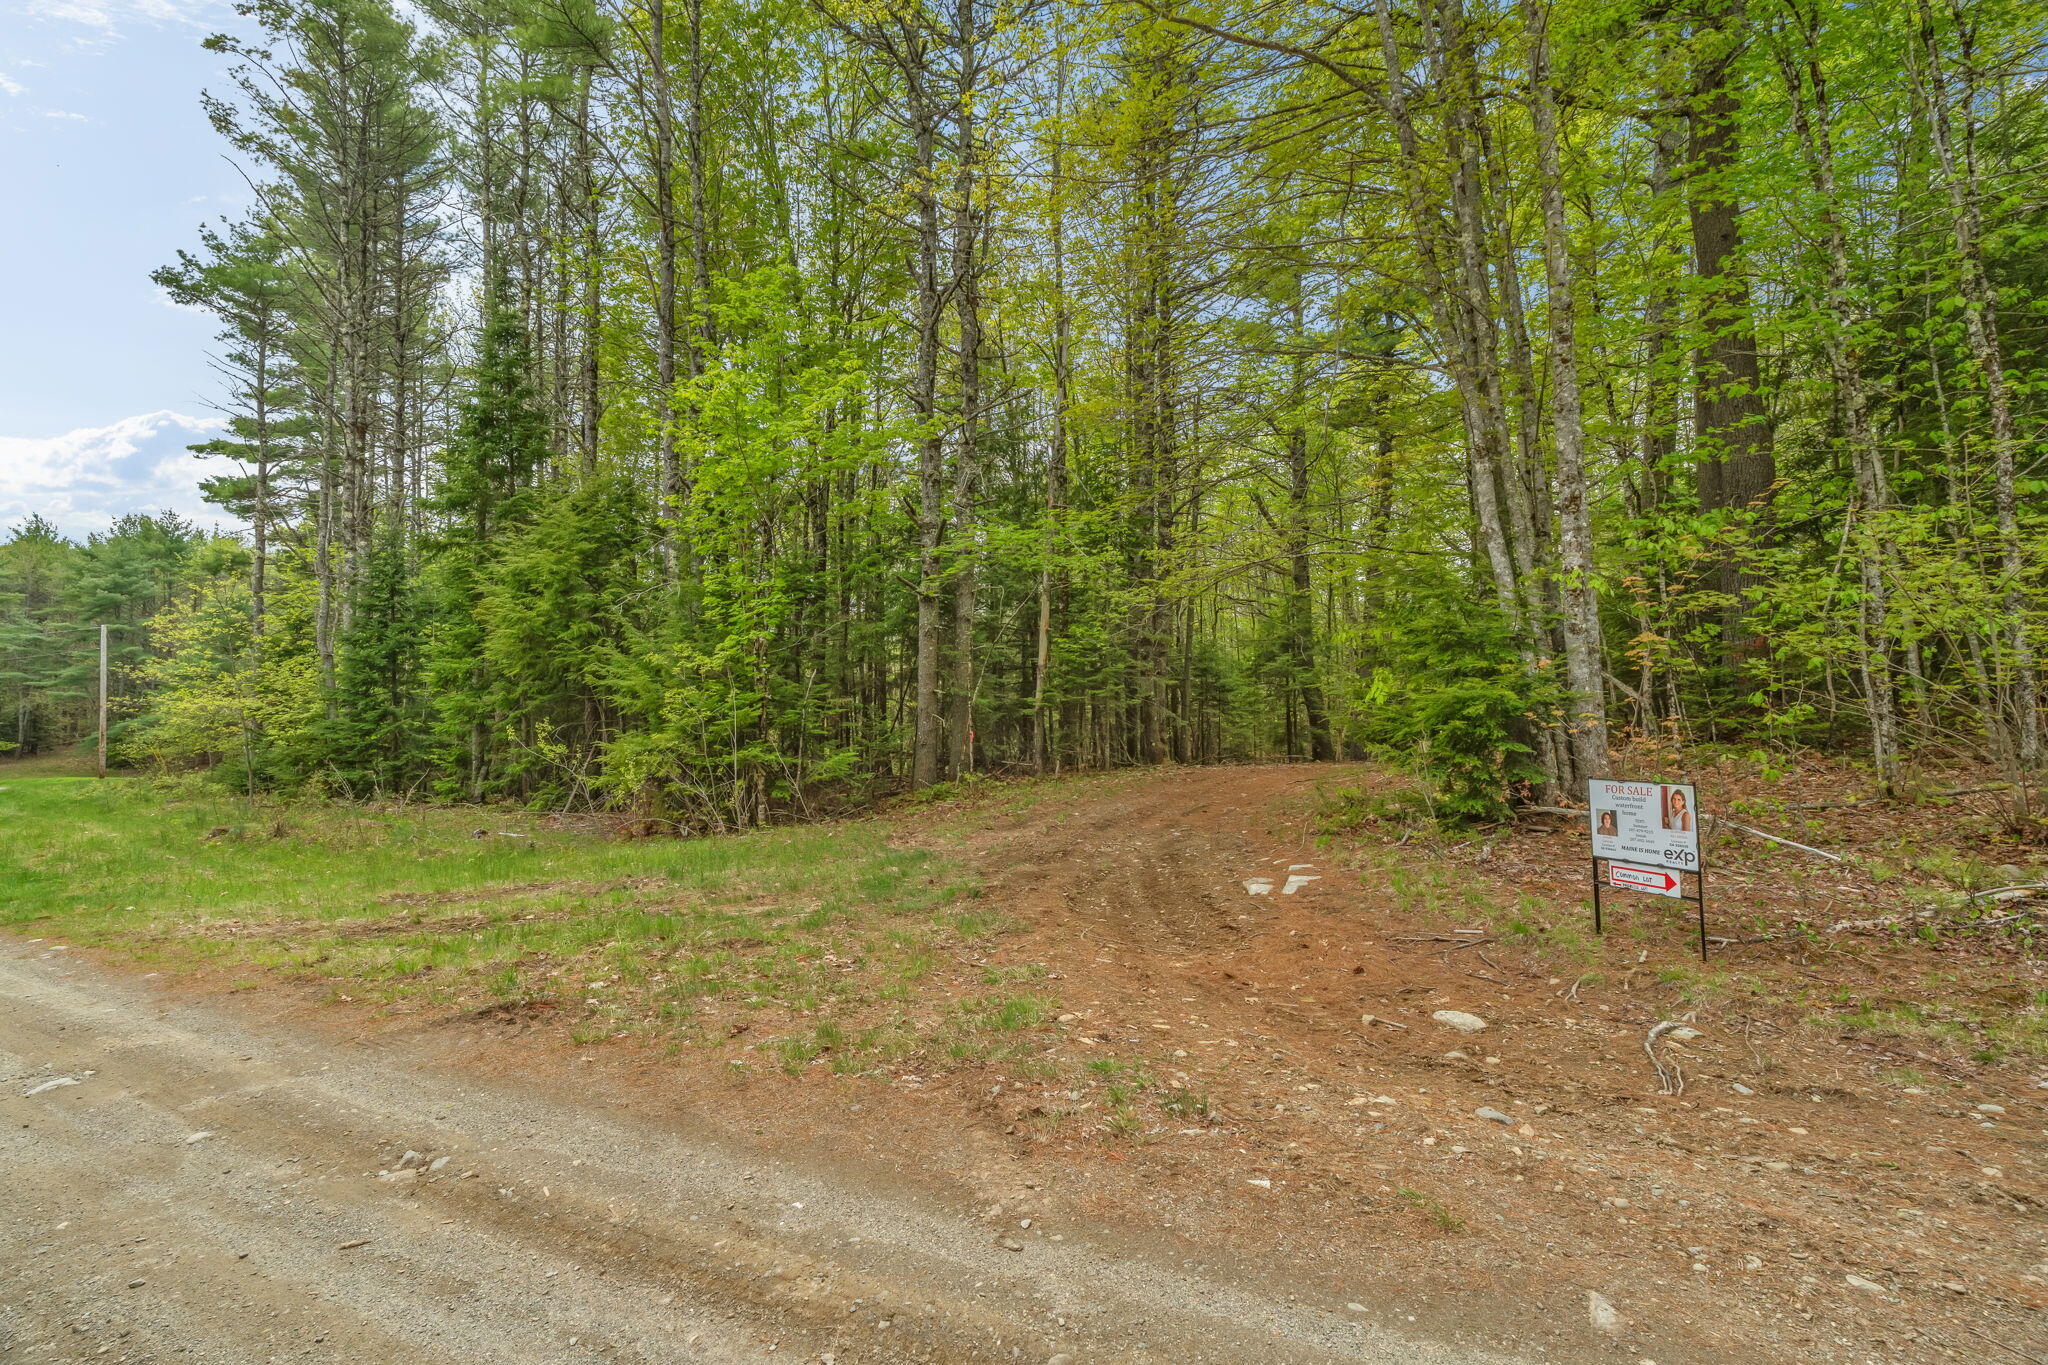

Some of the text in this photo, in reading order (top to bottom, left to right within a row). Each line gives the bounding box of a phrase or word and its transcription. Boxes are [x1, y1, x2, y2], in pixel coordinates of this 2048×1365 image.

[1605, 784, 1652, 797] FOR SALE
[1644, 848, 1661, 856] HOME
